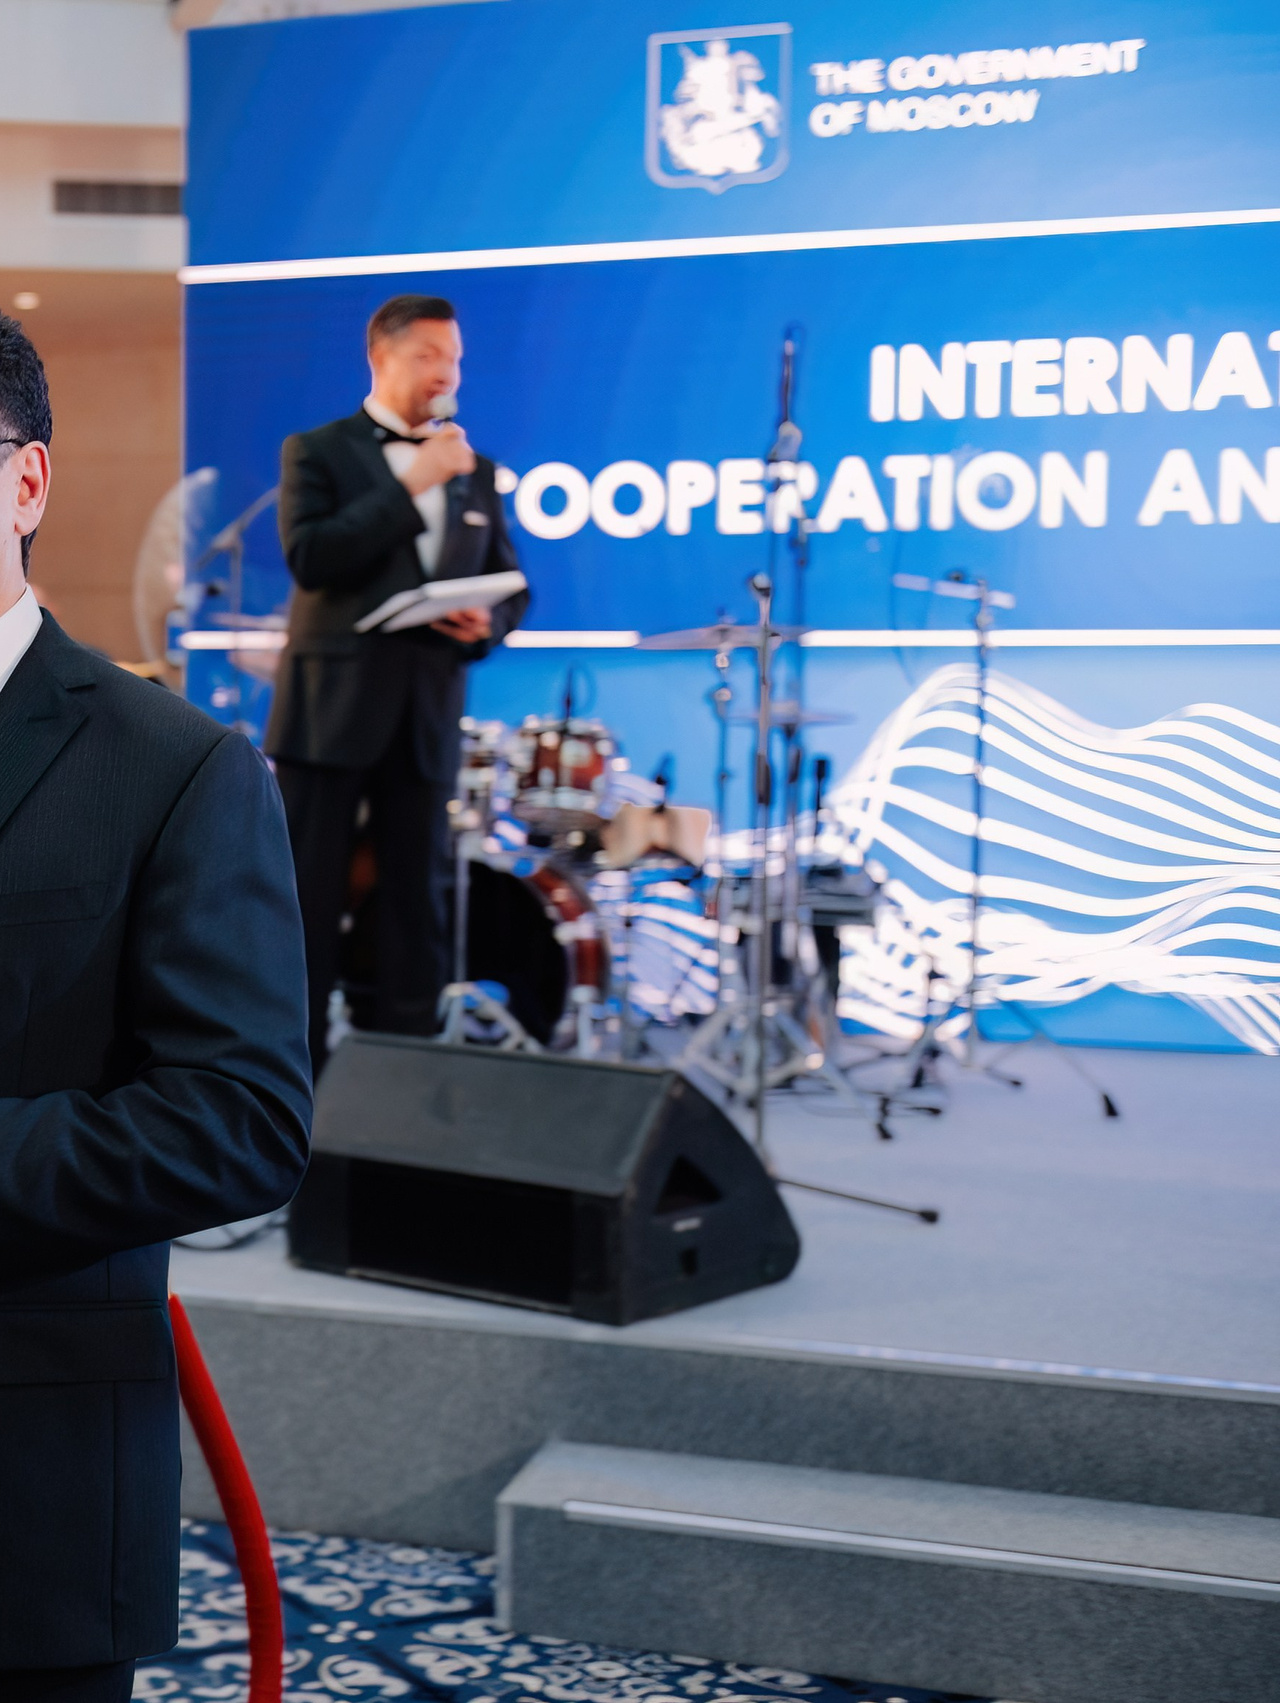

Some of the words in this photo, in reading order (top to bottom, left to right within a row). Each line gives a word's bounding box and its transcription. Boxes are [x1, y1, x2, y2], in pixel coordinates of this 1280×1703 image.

[814, 59, 884, 94] THE
[888, 39, 1145, 92] GOVERNMENT
[810, 101, 863, 137] OF
[867, 90, 1040, 132] MOSCOW
[869, 331, 1280, 422] INTERNA
